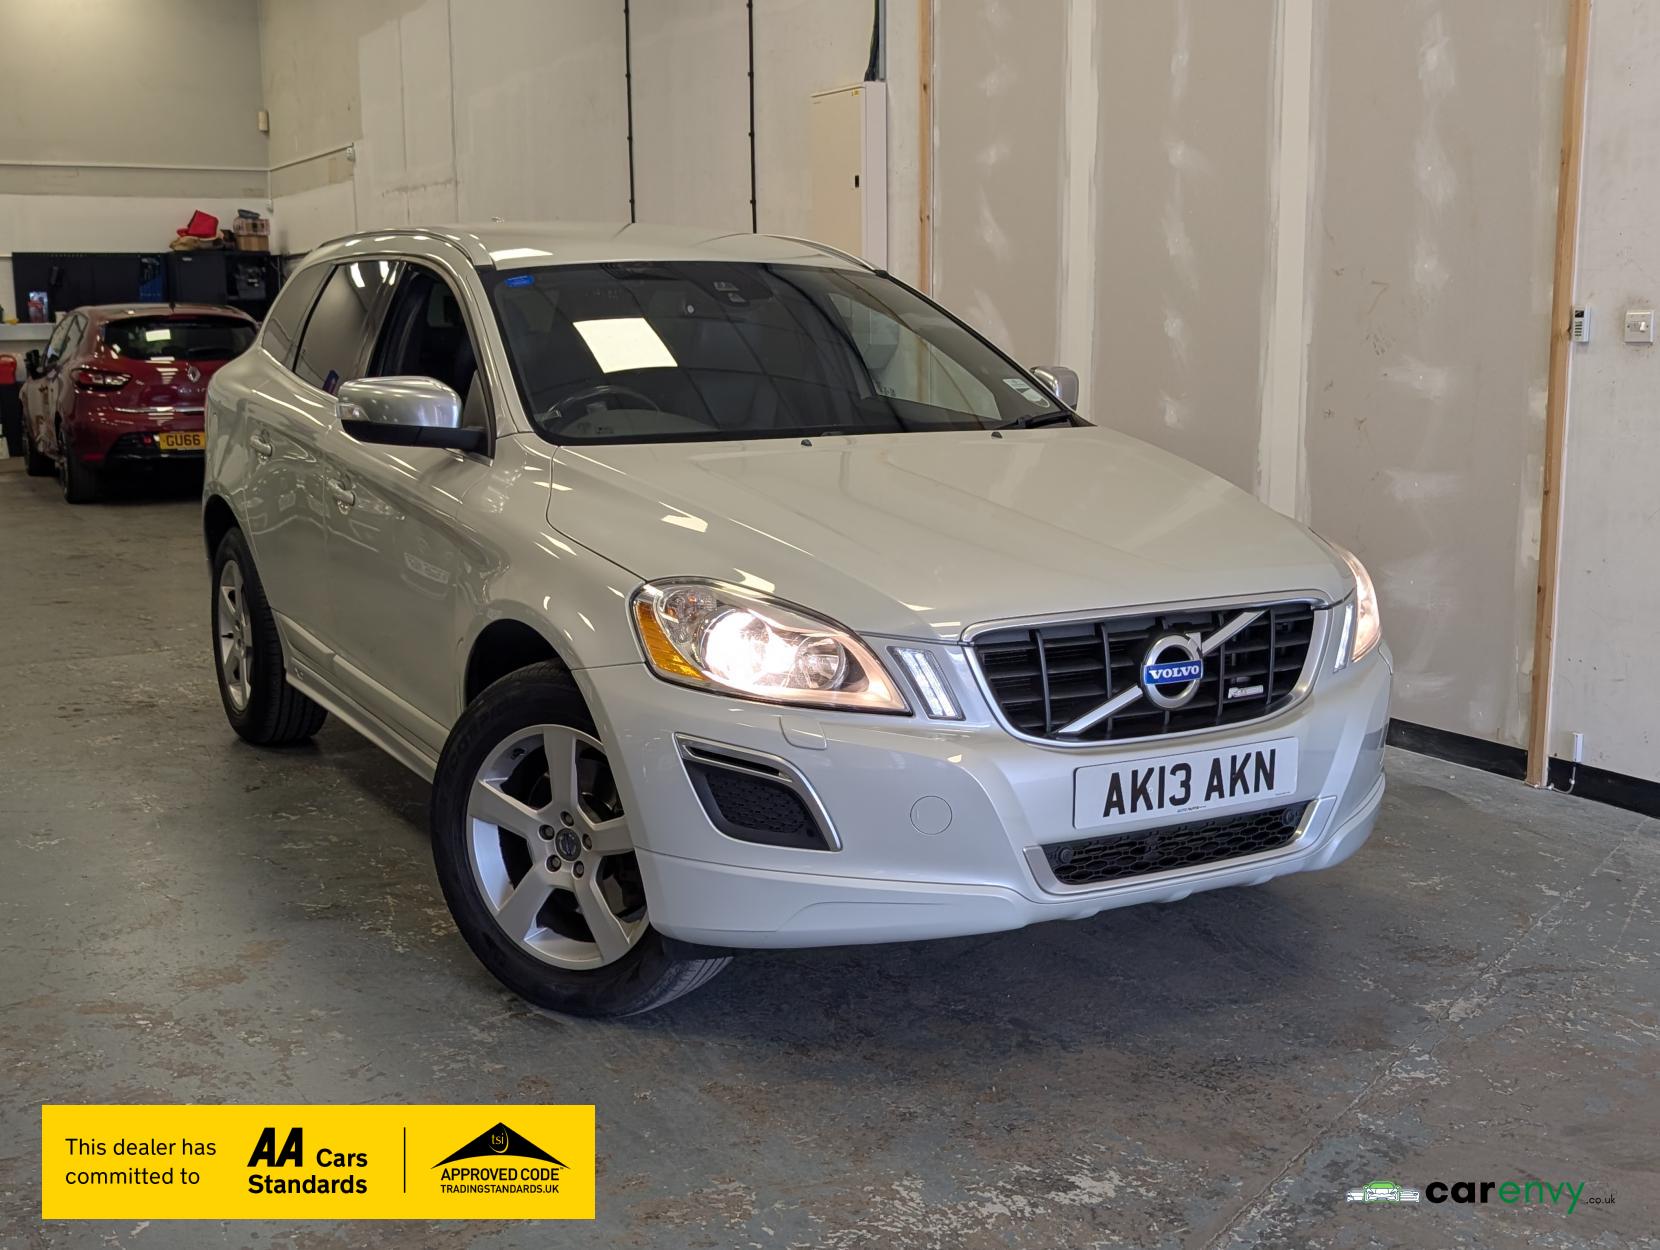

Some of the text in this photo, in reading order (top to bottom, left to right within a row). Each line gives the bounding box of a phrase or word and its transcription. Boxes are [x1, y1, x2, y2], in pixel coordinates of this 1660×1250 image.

[166, 433, 202, 448] GU66
[1149, 665, 1200, 680] VOLVO
[1103, 748, 1277, 818] AK13 AKN
